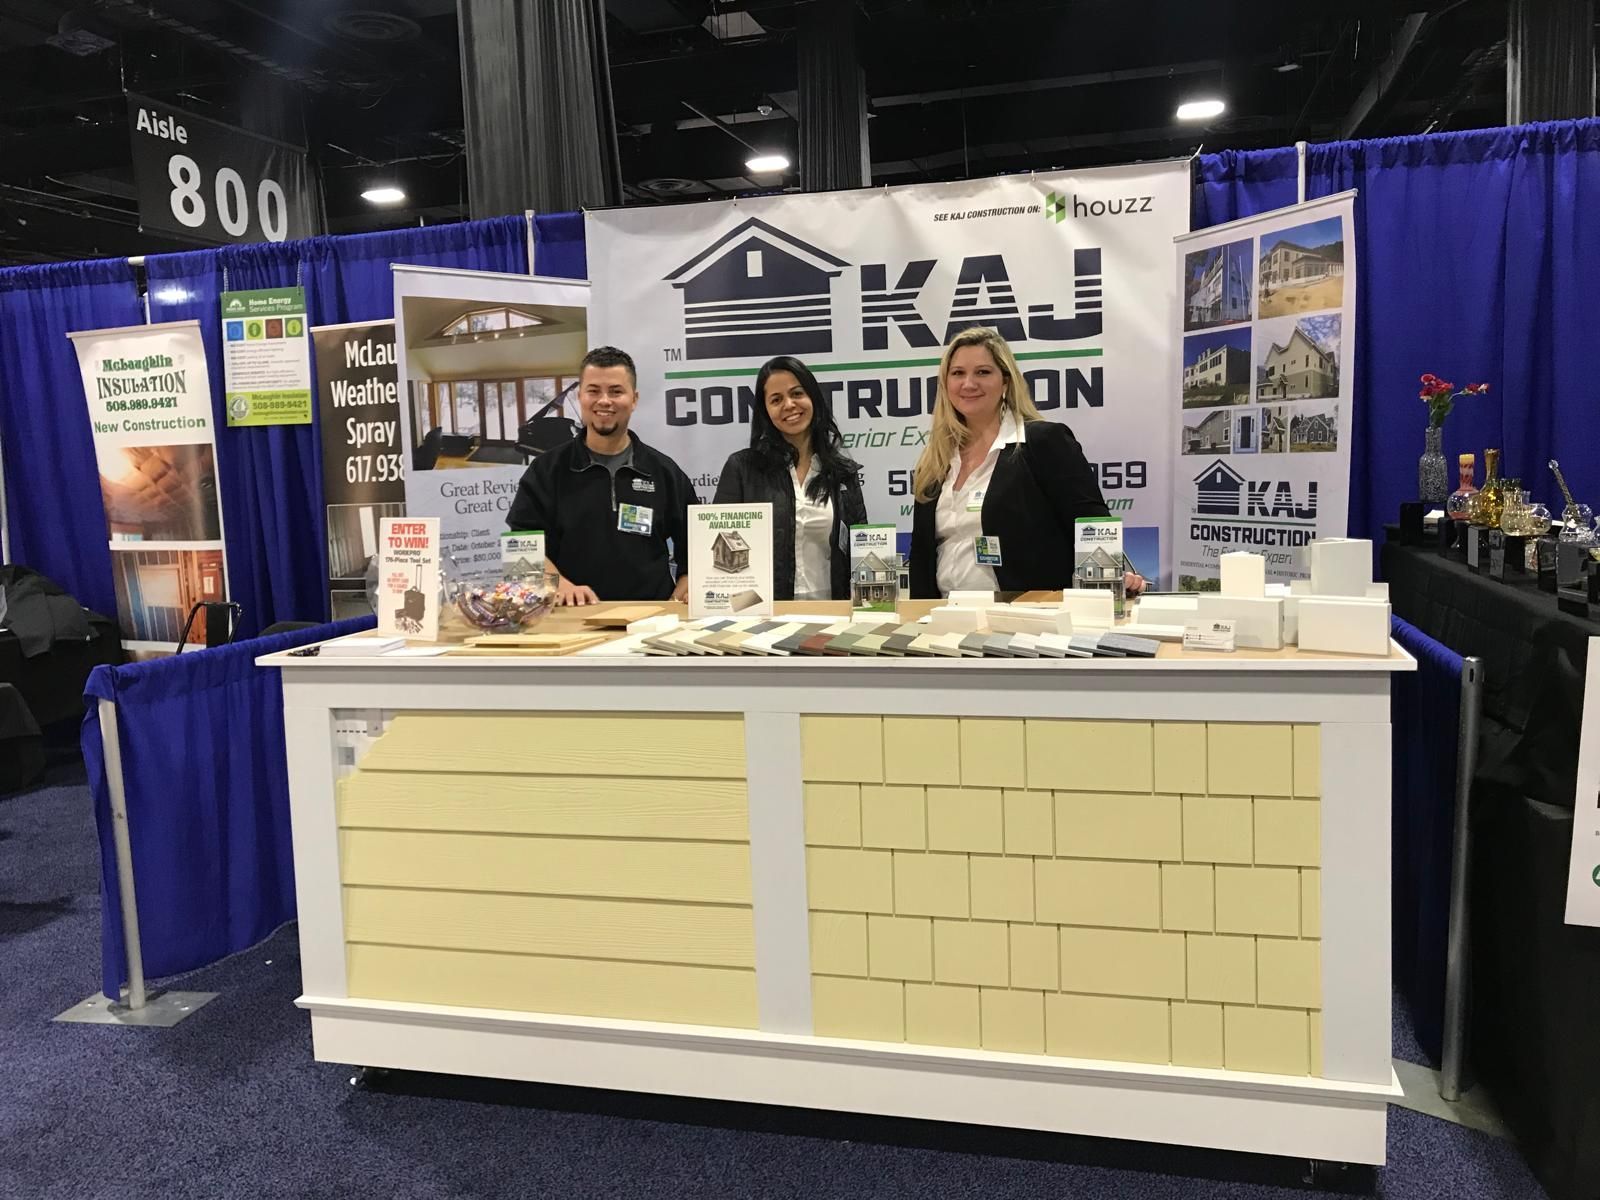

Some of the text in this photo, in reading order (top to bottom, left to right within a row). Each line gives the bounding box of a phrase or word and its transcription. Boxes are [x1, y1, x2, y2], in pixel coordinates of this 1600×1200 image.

[136, 108, 188, 144] Aisle
[168, 154, 288, 242] 800
[1073, 194, 1153, 218] houzz
[933, 205, 1041, 222] SEE KAJ CONSTRUCTION ON:
[249, 304, 275, 313] Services
[276, 303, 303, 312] Program
[268, 297, 291, 305] Energy
[860, 248, 1103, 351] KAJ
[102, 354, 173, 372] McLaughlin
[664, 349, 682, 361] TM
[96, 369, 187, 400] INSULATION
[106, 397, 178, 412] 508.989.9421
[665, 366, 1104, 427] COTRUON
[94, 416, 206, 433] New Construction
[346, 418, 396, 448] Spray
[440, 480, 520, 498] Great Revie
[455, 499, 493, 514] Great
[1247, 481, 1318, 519] KAJ
[697, 511, 763, 521] 100% FINANCING
[709, 520, 751, 529] AVAILABLE
[391, 523, 426, 535] ENTER
[869, 533, 887, 541] KAJ
[1097, 527, 1117, 536] KAJ
[1190, 524, 1316, 547] CONSTRUCTION
[388, 537, 402, 548] TO
[404, 537, 429, 549] WIN!
[1202, 545, 1220, 558] The
